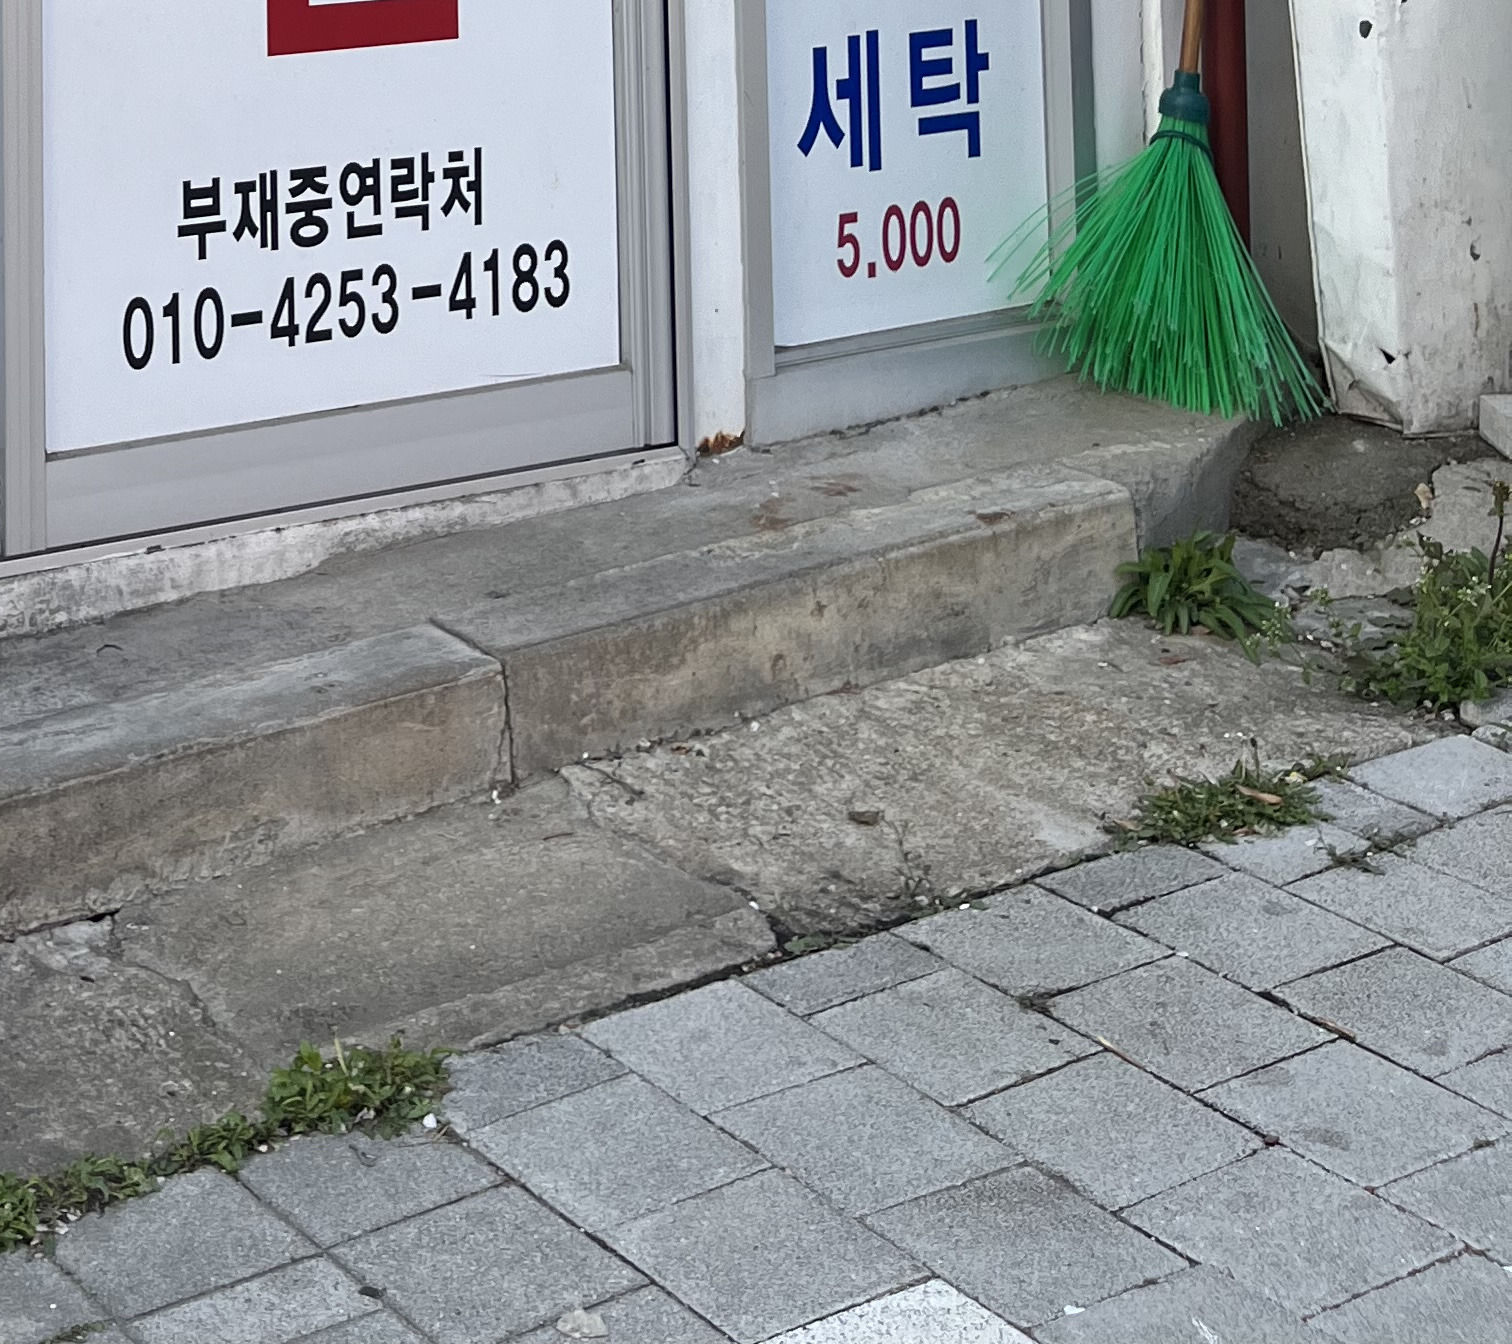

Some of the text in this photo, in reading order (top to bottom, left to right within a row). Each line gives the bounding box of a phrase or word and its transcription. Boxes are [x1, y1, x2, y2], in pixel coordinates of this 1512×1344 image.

[796, 18, 990, 172] 세탁
[177, 146, 483, 260] 부재중연락처
[835, 196, 962, 280] 5.000
[122, 239, 571, 370] 010-4253-4183
